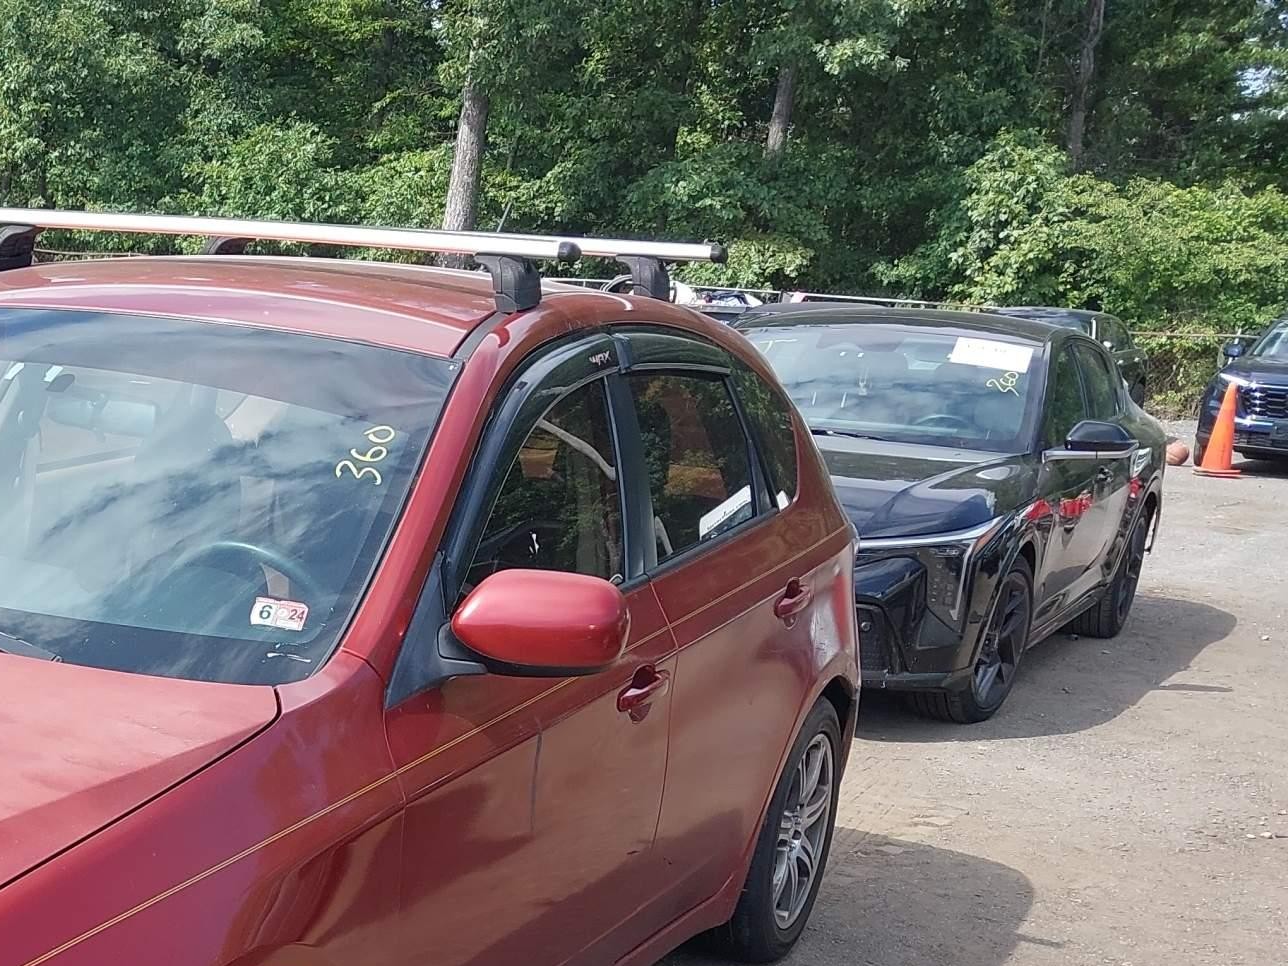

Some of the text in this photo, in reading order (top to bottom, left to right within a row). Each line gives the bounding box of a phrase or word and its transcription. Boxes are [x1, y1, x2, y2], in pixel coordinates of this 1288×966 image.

[335, 424, 396, 486] 360
[258, 604, 306, 622] 6 24
